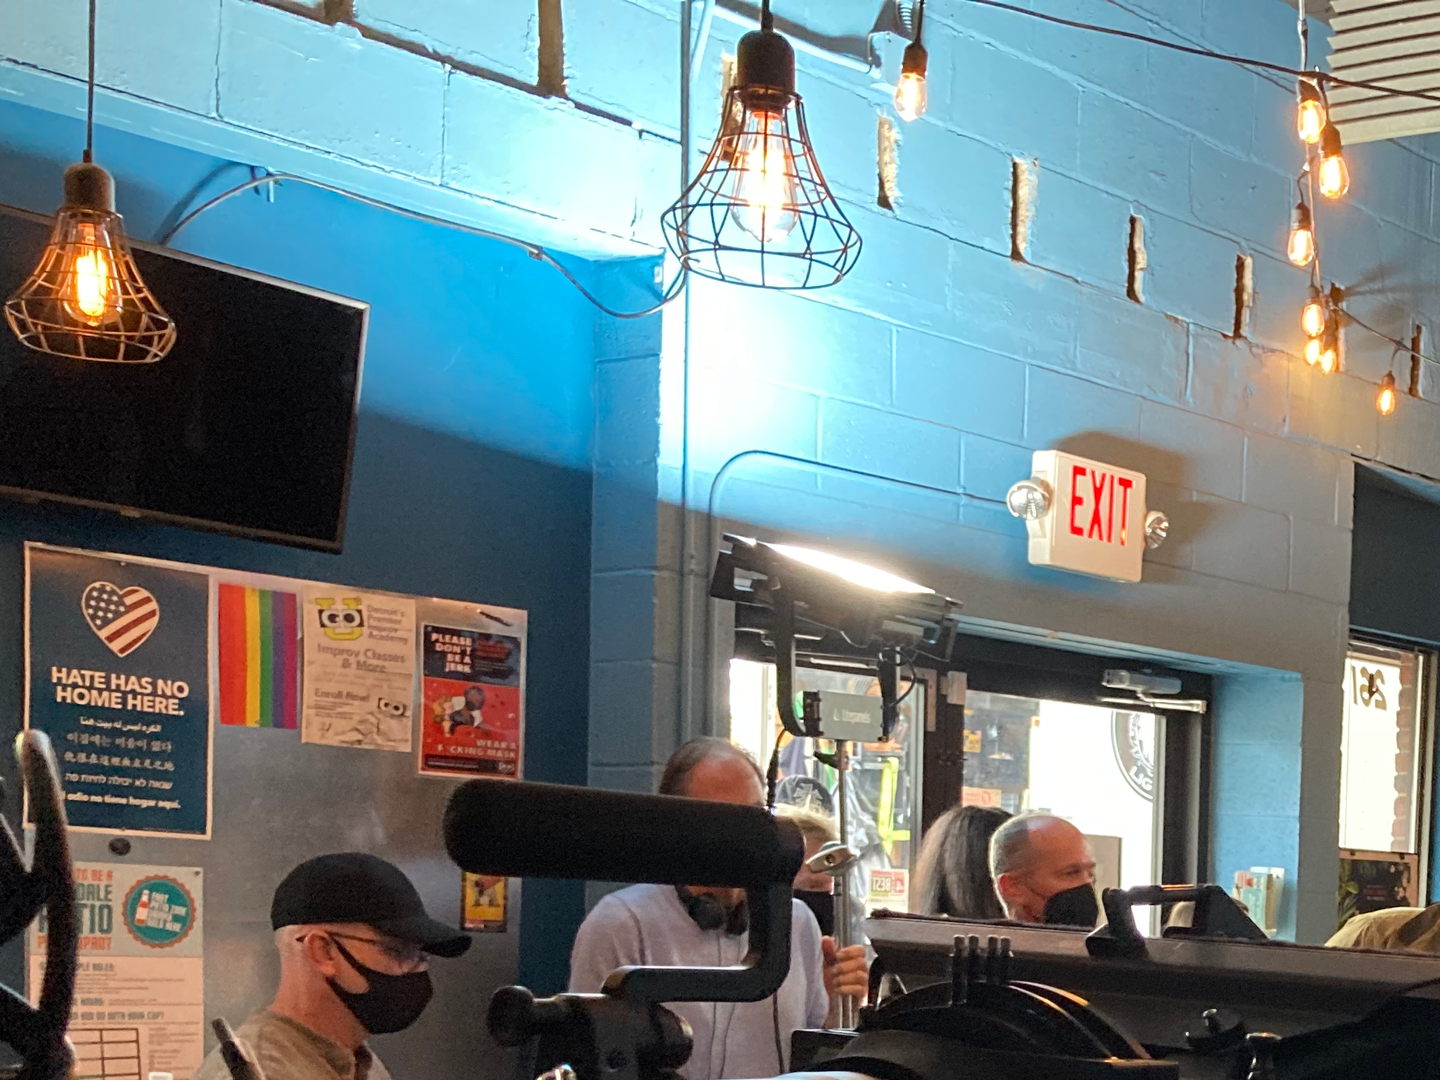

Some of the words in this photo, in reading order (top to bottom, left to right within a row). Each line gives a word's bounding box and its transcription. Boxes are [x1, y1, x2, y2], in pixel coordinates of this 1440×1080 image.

[1070, 465, 1134, 546] EXIT
[431, 633, 472, 646] PLEASE
[318, 644, 360, 658] Improv
[364, 649, 405, 663] Classes
[436, 643, 472, 654] DON'T
[342, 658, 352, 669] &
[356, 660, 387, 673] More
[447, 654, 461, 663] BE
[464, 655, 472, 663] A
[445, 663, 471, 673] JERK
[52, 667, 106, 688] HATE
[111, 674, 153, 694] HAS
[157, 679, 190, 698] NO
[56, 686, 123, 709] HOME
[128, 695, 185, 716] HERE.
[438, 744, 484, 756] FCKING
[487, 748, 516, 758] MASK
[476, 740, 508, 749] WEAR
[76, 869, 88, 881] TO
[91, 869, 104, 881] BE
[107, 870, 113, 882] A
[76, 883, 113, 902] DALE
